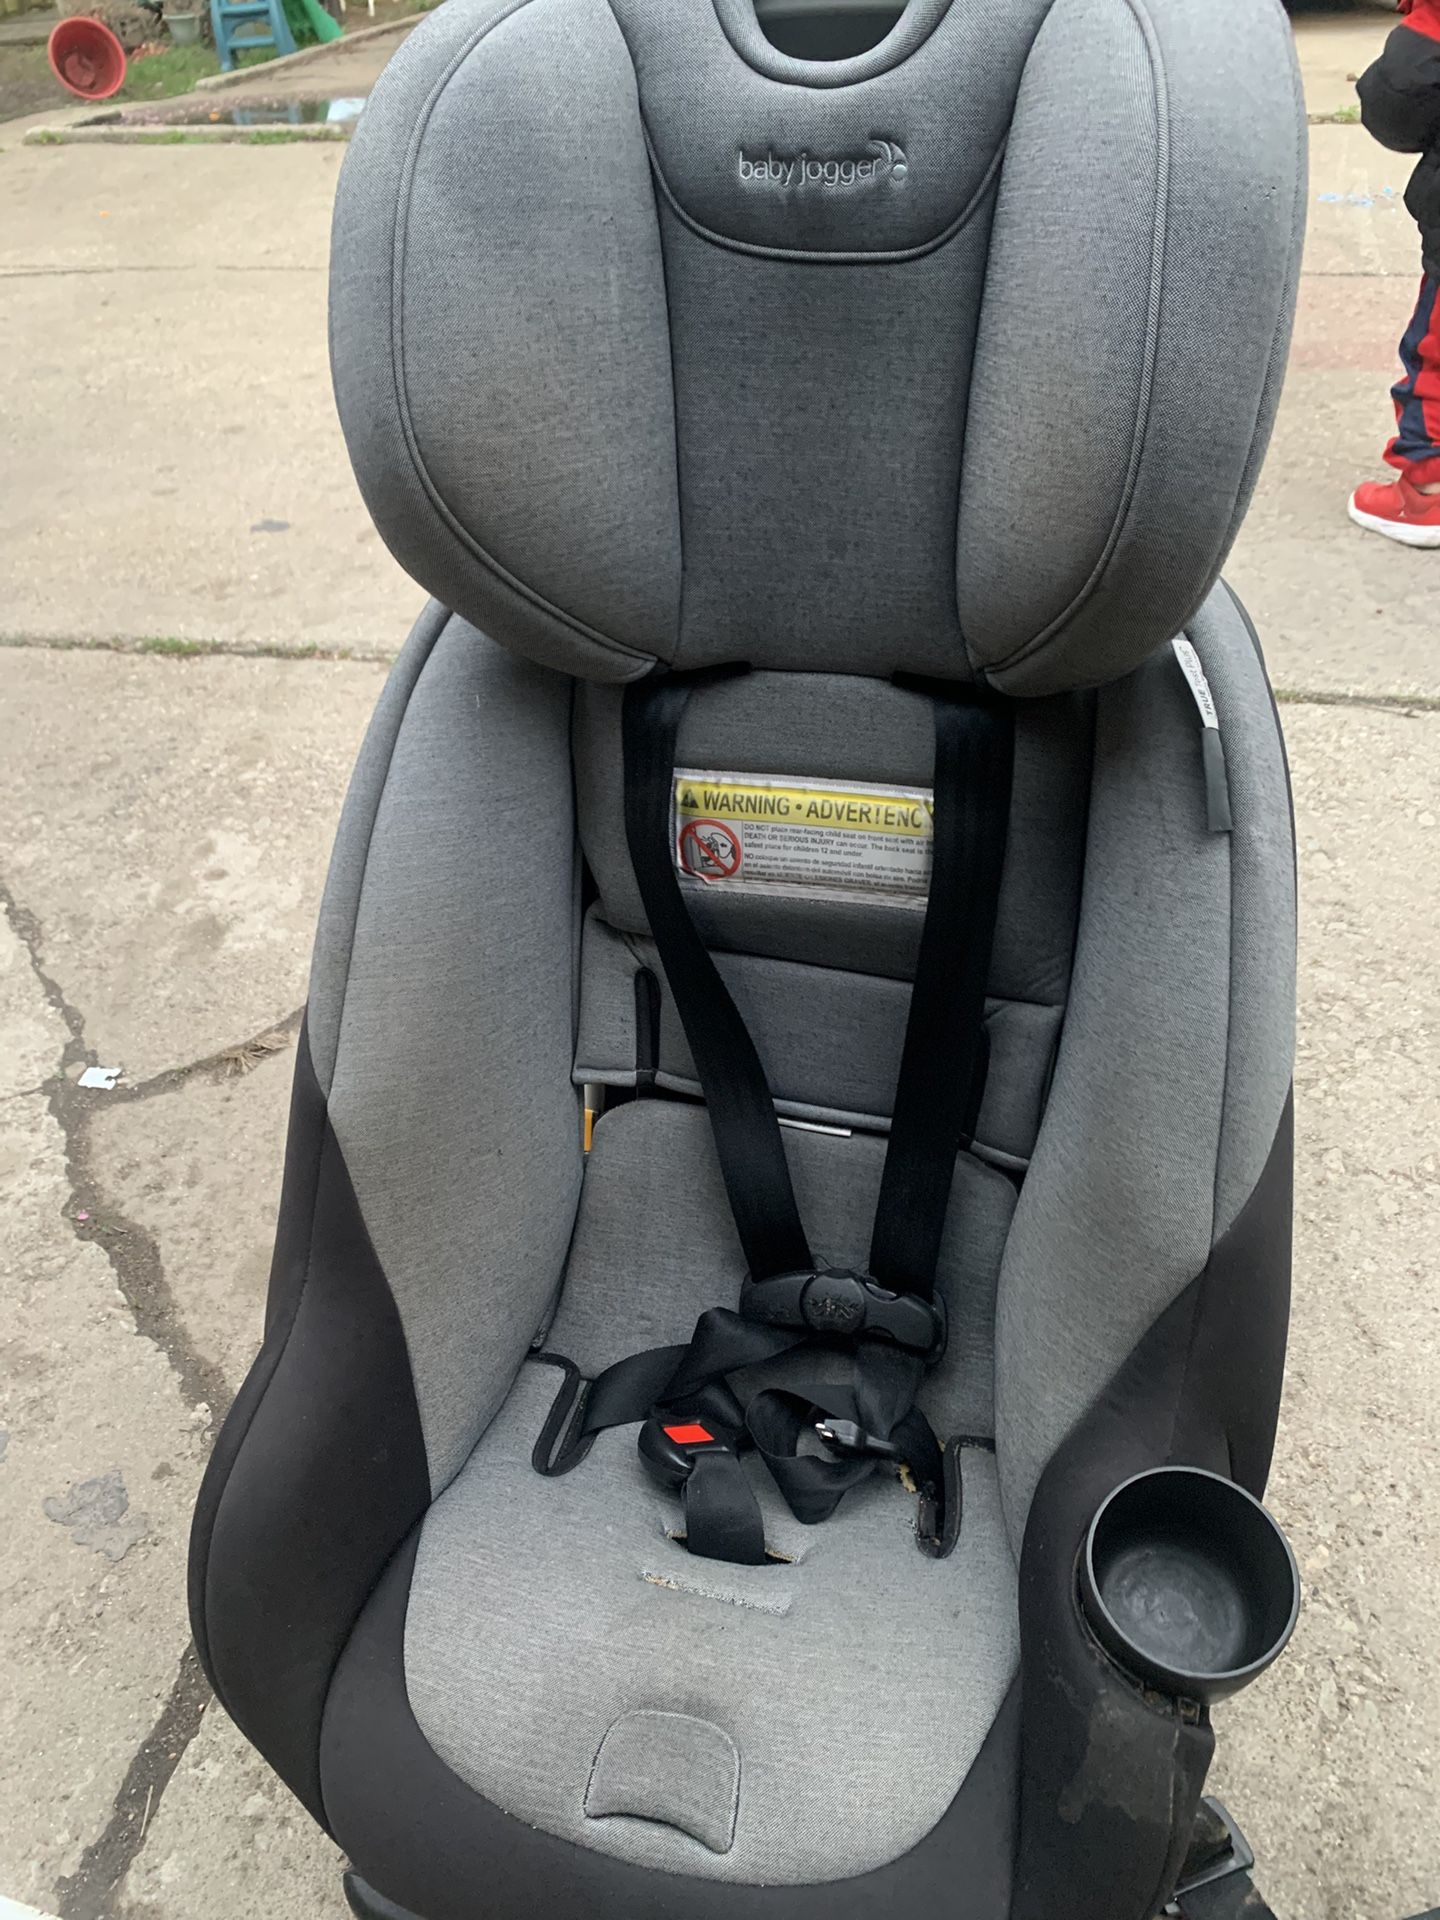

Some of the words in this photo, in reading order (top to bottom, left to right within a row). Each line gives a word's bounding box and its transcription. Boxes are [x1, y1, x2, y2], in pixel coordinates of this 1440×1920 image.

[739, 151, 794, 187] baby
[799, 152, 882, 187] jogger
[1198, 689, 1214, 716] TRUE
[703, 790, 790, 816] WARNING
[806, 801, 926, 828] ADVERTENC
[744, 832, 766, 840] DEATH
[779, 834, 808, 843] SERIOUS
[810, 837, 833, 845] INJURY
[789, 827, 824, 837] rear-facing
[825, 830, 841, 838] child
[842, 831, 856, 839] seat
[793, 844, 819, 853] children
